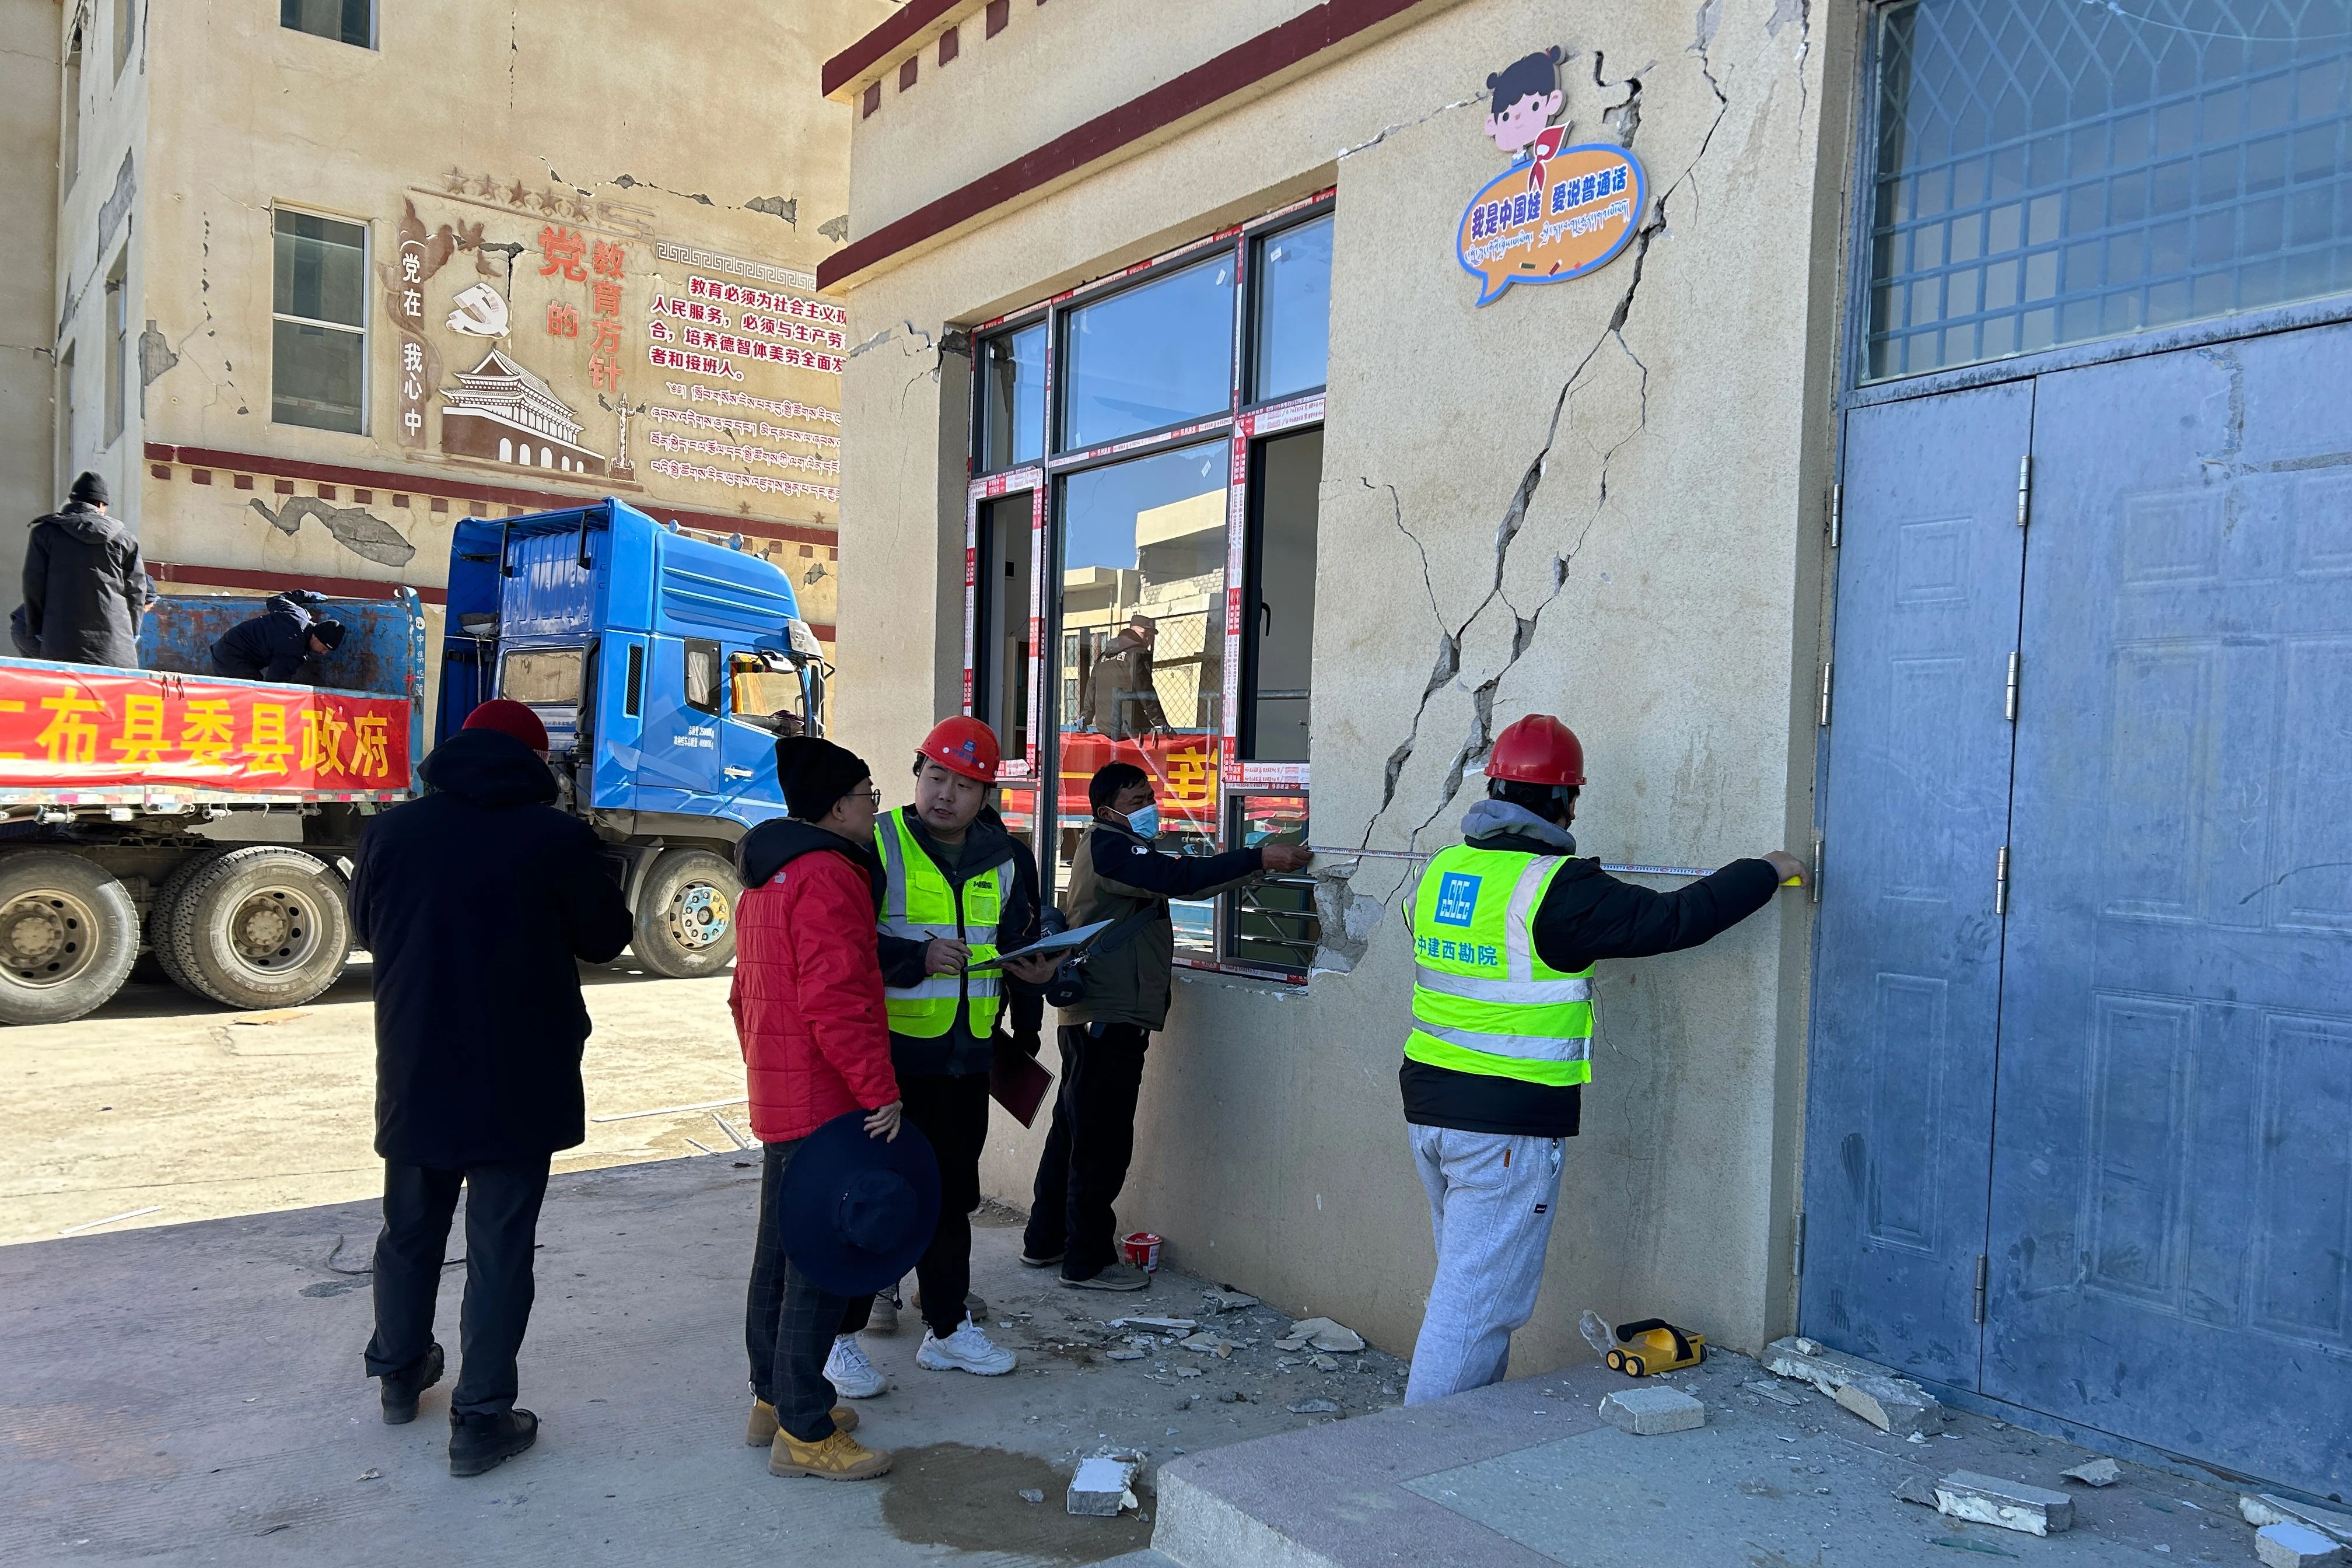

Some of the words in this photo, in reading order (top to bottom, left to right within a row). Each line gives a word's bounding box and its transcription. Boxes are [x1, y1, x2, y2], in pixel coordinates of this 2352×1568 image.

[1472, 191, 1541, 240] 我是中国娃
[1552, 166, 1626, 214] 爱说普通话
[589, 240, 625, 393] 教育方针
[651, 348, 743, 379] 者和接班人。
[1418, 935, 1499, 966] 中建西勘院
